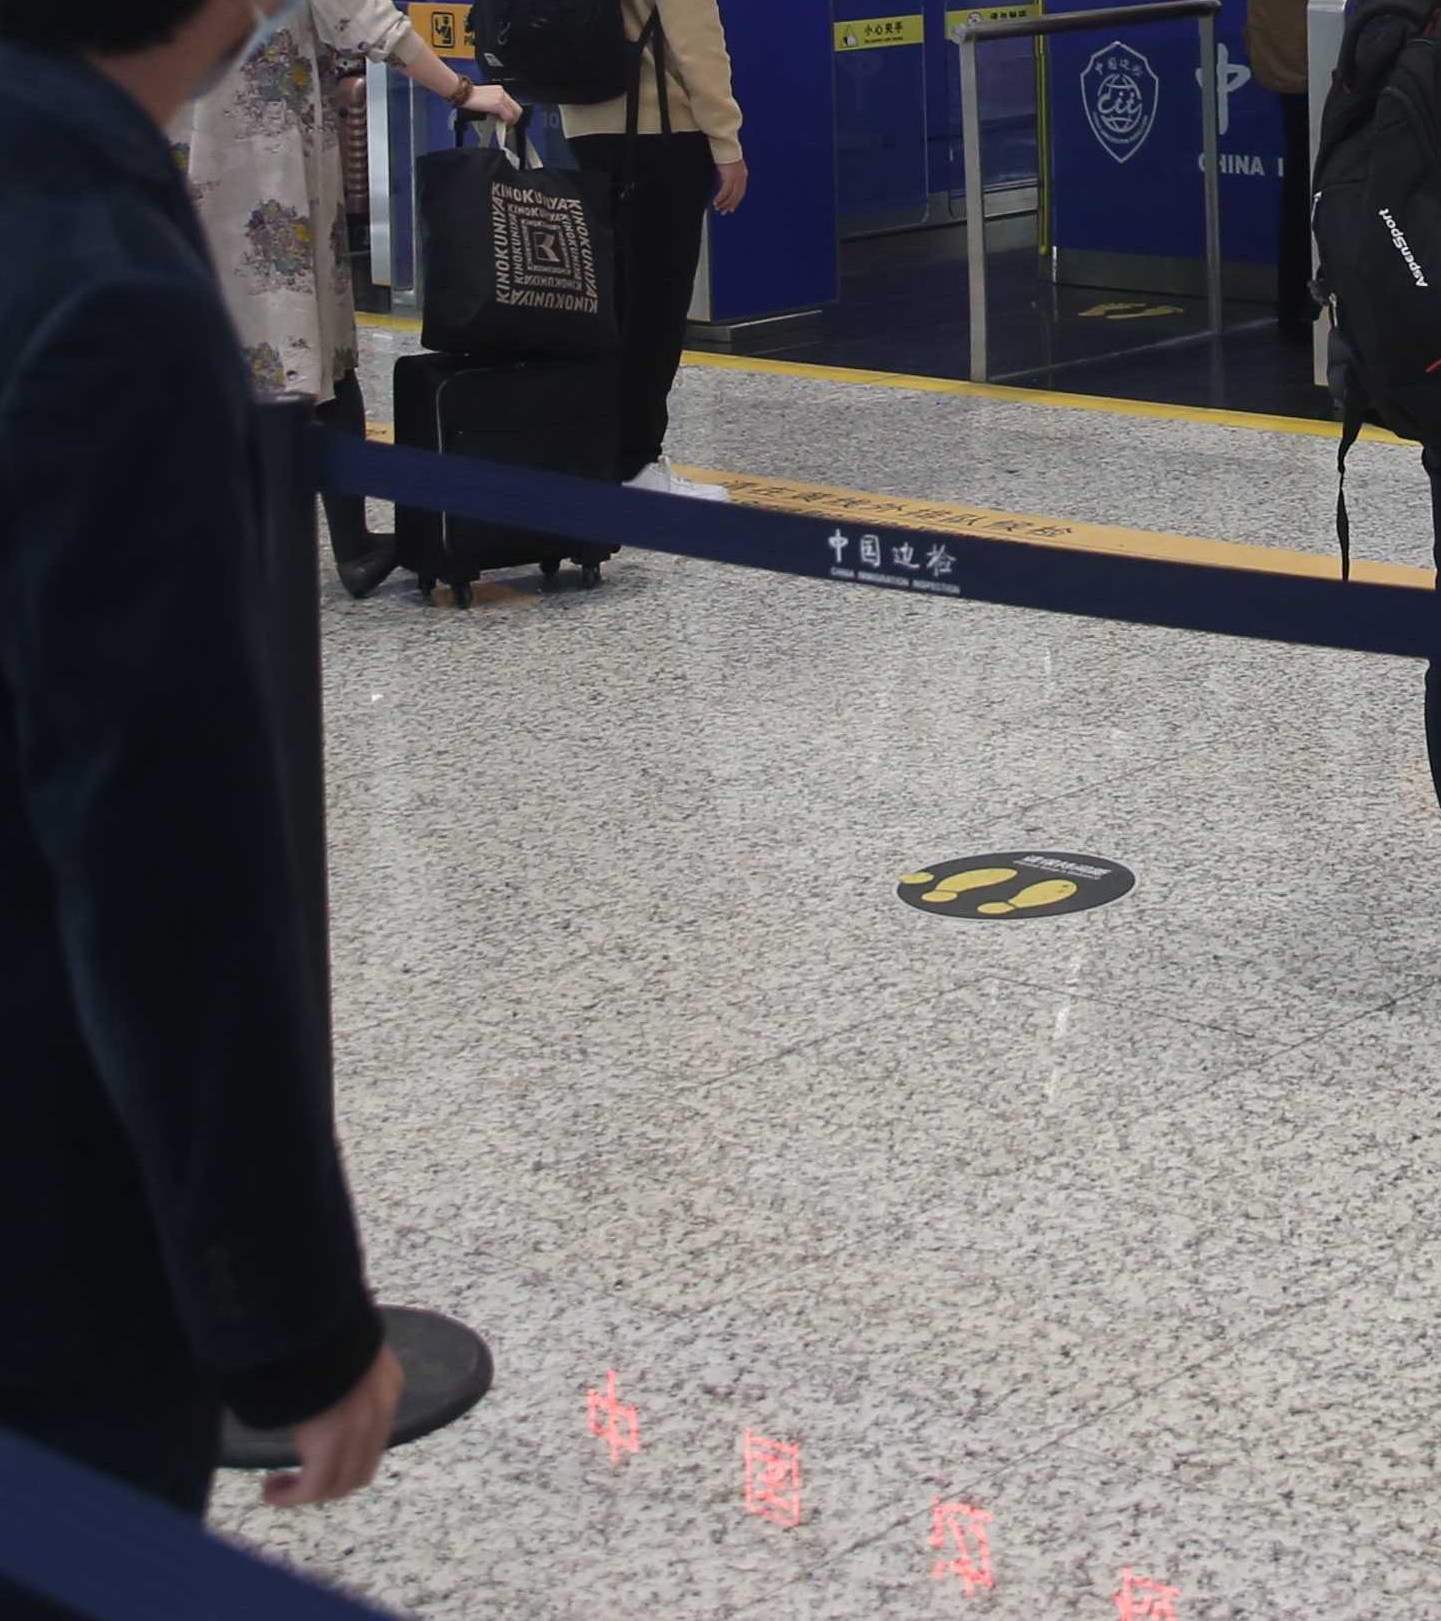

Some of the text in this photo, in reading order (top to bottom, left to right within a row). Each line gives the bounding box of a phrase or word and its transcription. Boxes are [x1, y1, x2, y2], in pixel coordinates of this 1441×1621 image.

[491, 196, 511, 304] KINOKUNIYA
[1378, 207, 1429, 288] AspenSport
[827, 528, 958, 577] 中国边检
